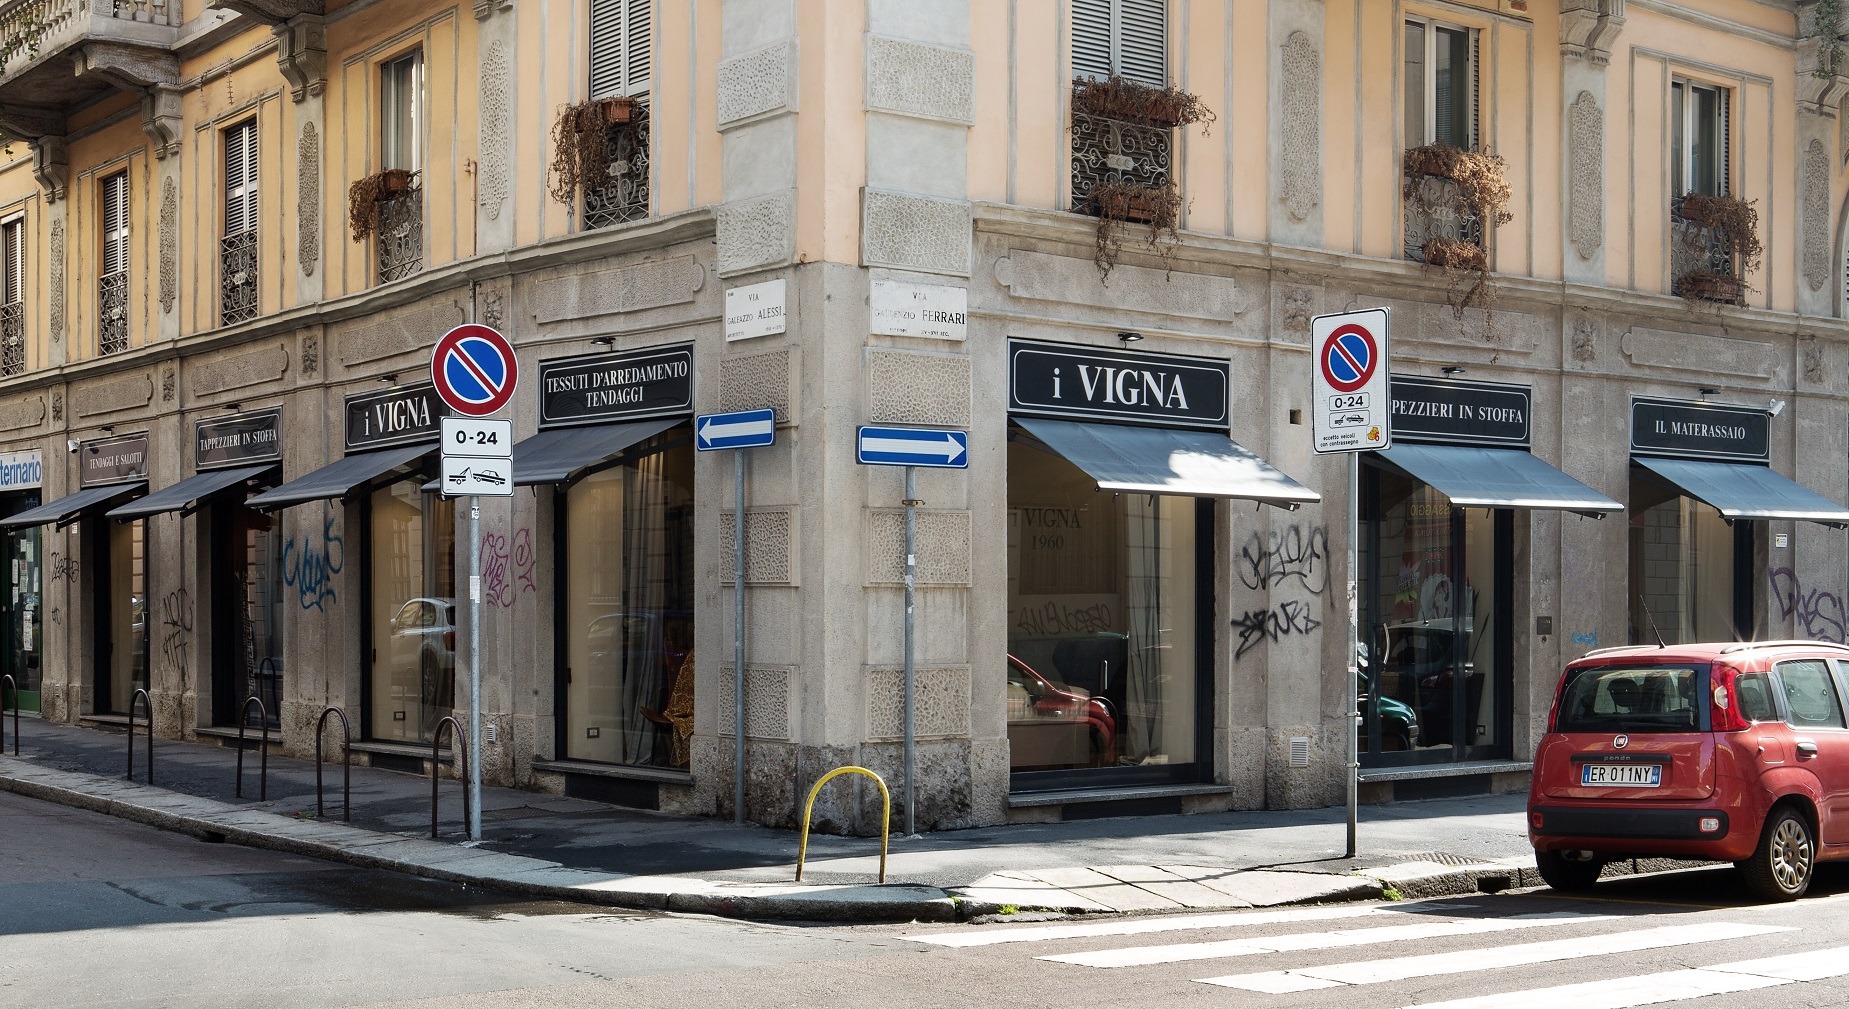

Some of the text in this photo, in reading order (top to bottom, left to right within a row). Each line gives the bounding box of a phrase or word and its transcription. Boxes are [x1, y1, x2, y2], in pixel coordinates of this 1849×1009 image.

[748, 293, 760, 301] VIA
[912, 291, 927, 301] VIA
[727, 305, 782, 325] GALEAZZO ALESSI
[922, 309, 966, 325] FERRARI
[546, 360, 688, 393] TESSUTI D'ARREDAMENTO
[1052, 364, 1190, 410] i VIGNA
[585, 386, 644, 408] TENDAGGI
[1334, 395, 1364, 408] 0-24
[364, 395, 431, 436] i VIGNA
[1459, 404, 1474, 419] IN
[1478, 406, 1523, 424] STOFFA
[455, 430, 498, 445] 0-24
[1323, 433, 1340, 441] eccetto
[1655, 419, 1746, 440] IL MATERASSAIO
[200, 428, 277, 451] TAPPEZZIERI IN STOFFA
[1328, 439, 1359, 447] contrassegno
[89, 451, 142, 470] TENDAGGI E SALOTTI
[1023, 508, 1082, 528] VIGNA
[1031, 534, 1065, 550] 1960
[1590, 767, 1606, 782] ER
[1610, 767, 1651, 782] 011NY
